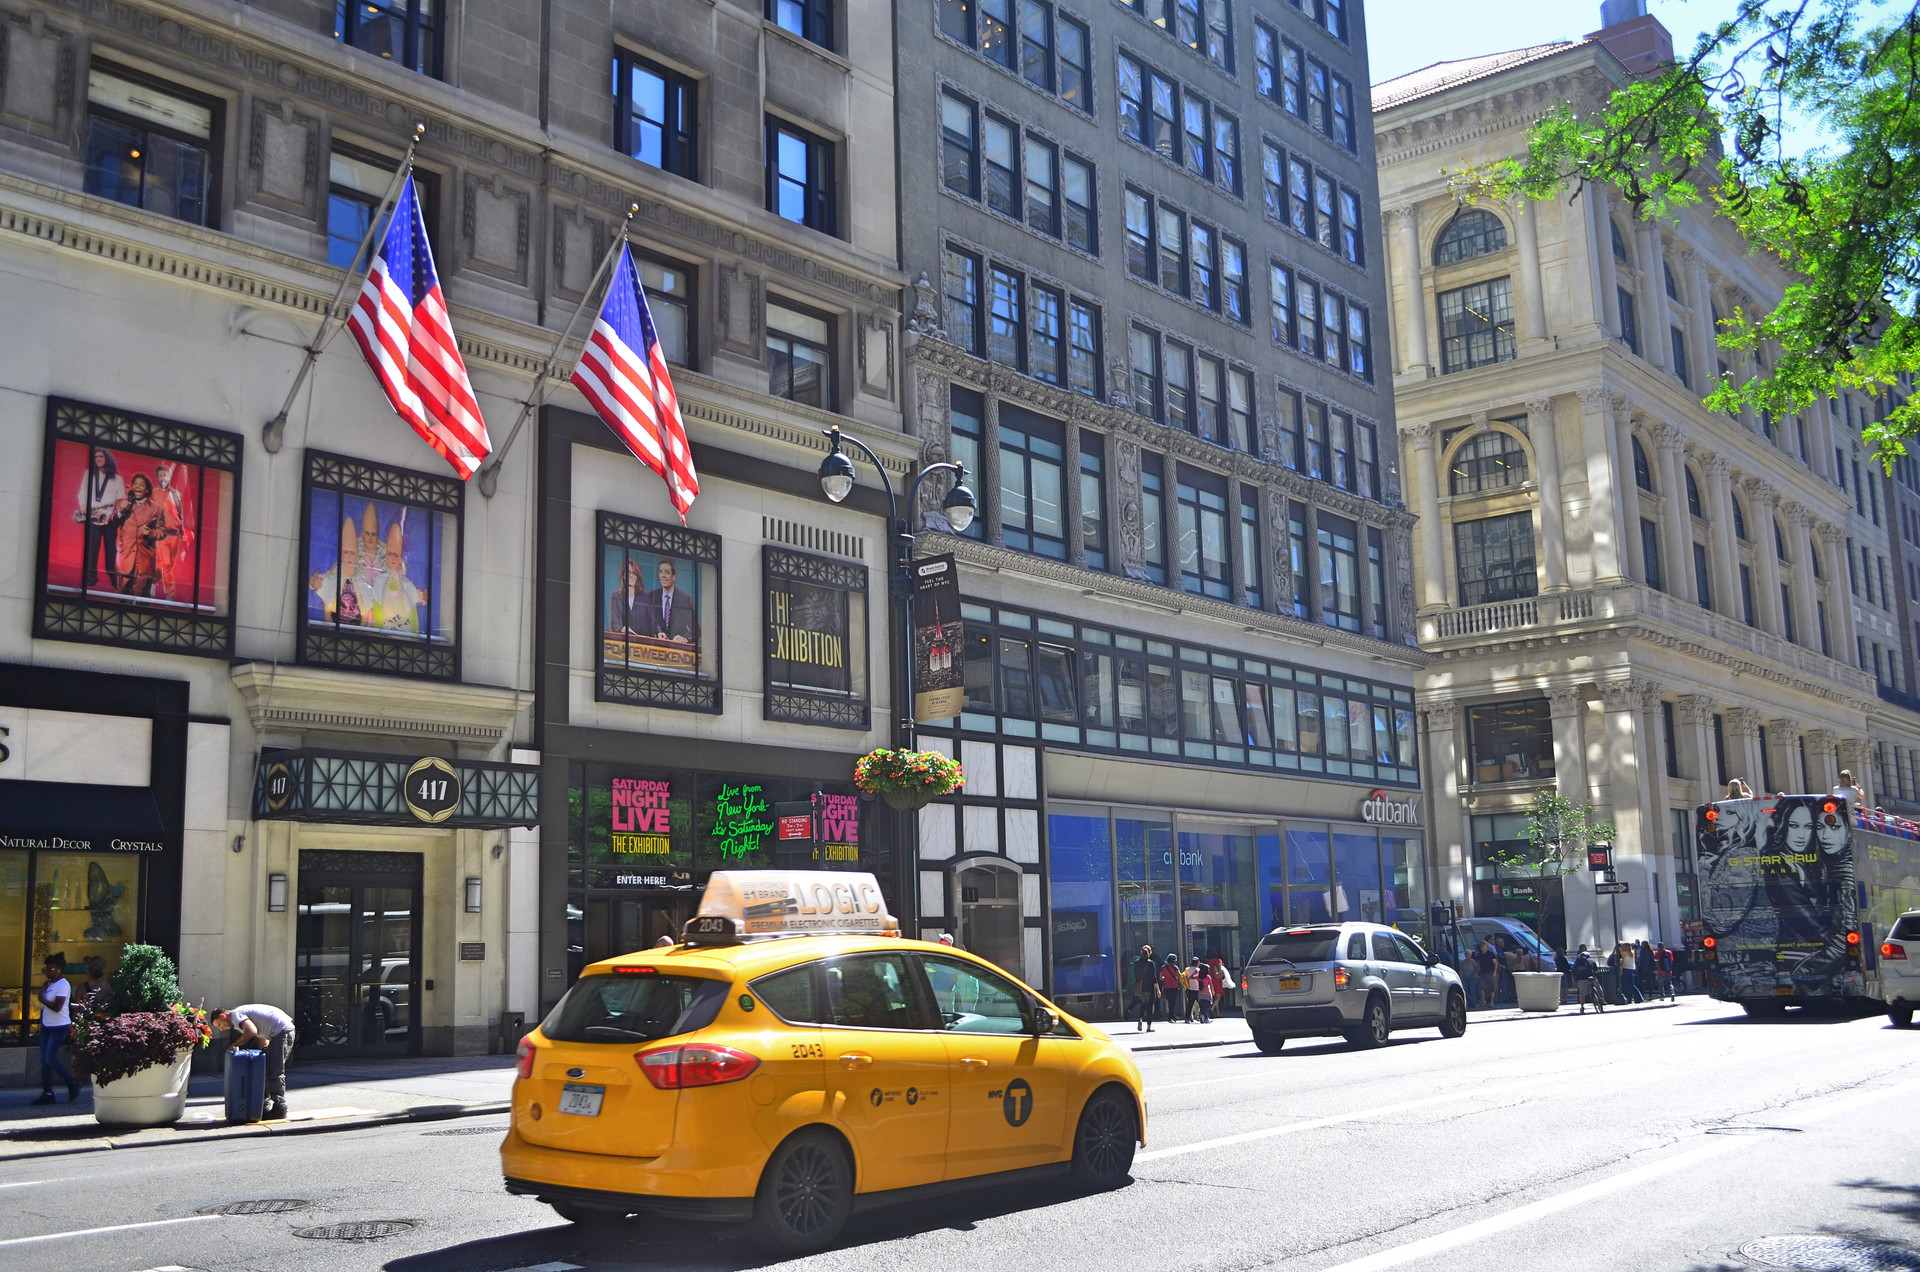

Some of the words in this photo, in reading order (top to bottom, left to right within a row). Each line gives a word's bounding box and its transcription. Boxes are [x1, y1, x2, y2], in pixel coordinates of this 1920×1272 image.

[271, 777, 287, 795] 417
[418, 779, 448, 801] 417
[612, 778, 670, 792] SATURDAY
[717, 783, 740, 801] Live
[742, 784, 763, 797] from
[612, 789, 670, 809] NIGHT
[811, 793, 858, 805] STURDAY
[717, 801, 742, 820] New
[1361, 795, 1418, 825] citibank
[612, 806, 670, 833] LIVE
[728, 818, 775, 837] Saturday
[0, 836, 50, 849] NATURAL
[52, 837, 92, 850] DECOR
[111, 839, 163, 851] CRYSTALS
[612, 836, 627, 853] THE
[628, 836, 670, 854] EXHIBITION
[720, 833, 760, 860] Night!
[1163, 849, 1204, 866] cibank
[616, 875, 642, 885] ENTER
[644, 876, 667, 886] HERE!
[758, 890, 789, 899] BRAND
[793, 882, 880, 916] LOGIC
[699, 918, 724, 932] 2D43
[750, 920, 788, 930] PREMIUM
[789, 919, 837, 929] ELECTRONIC
[837, 918, 880, 928] CIGARETTES
[791, 1043, 823, 1058] 2D43
[988, 1090, 1003, 1099] NYC
[1010, 1088, 1028, 1121] T
